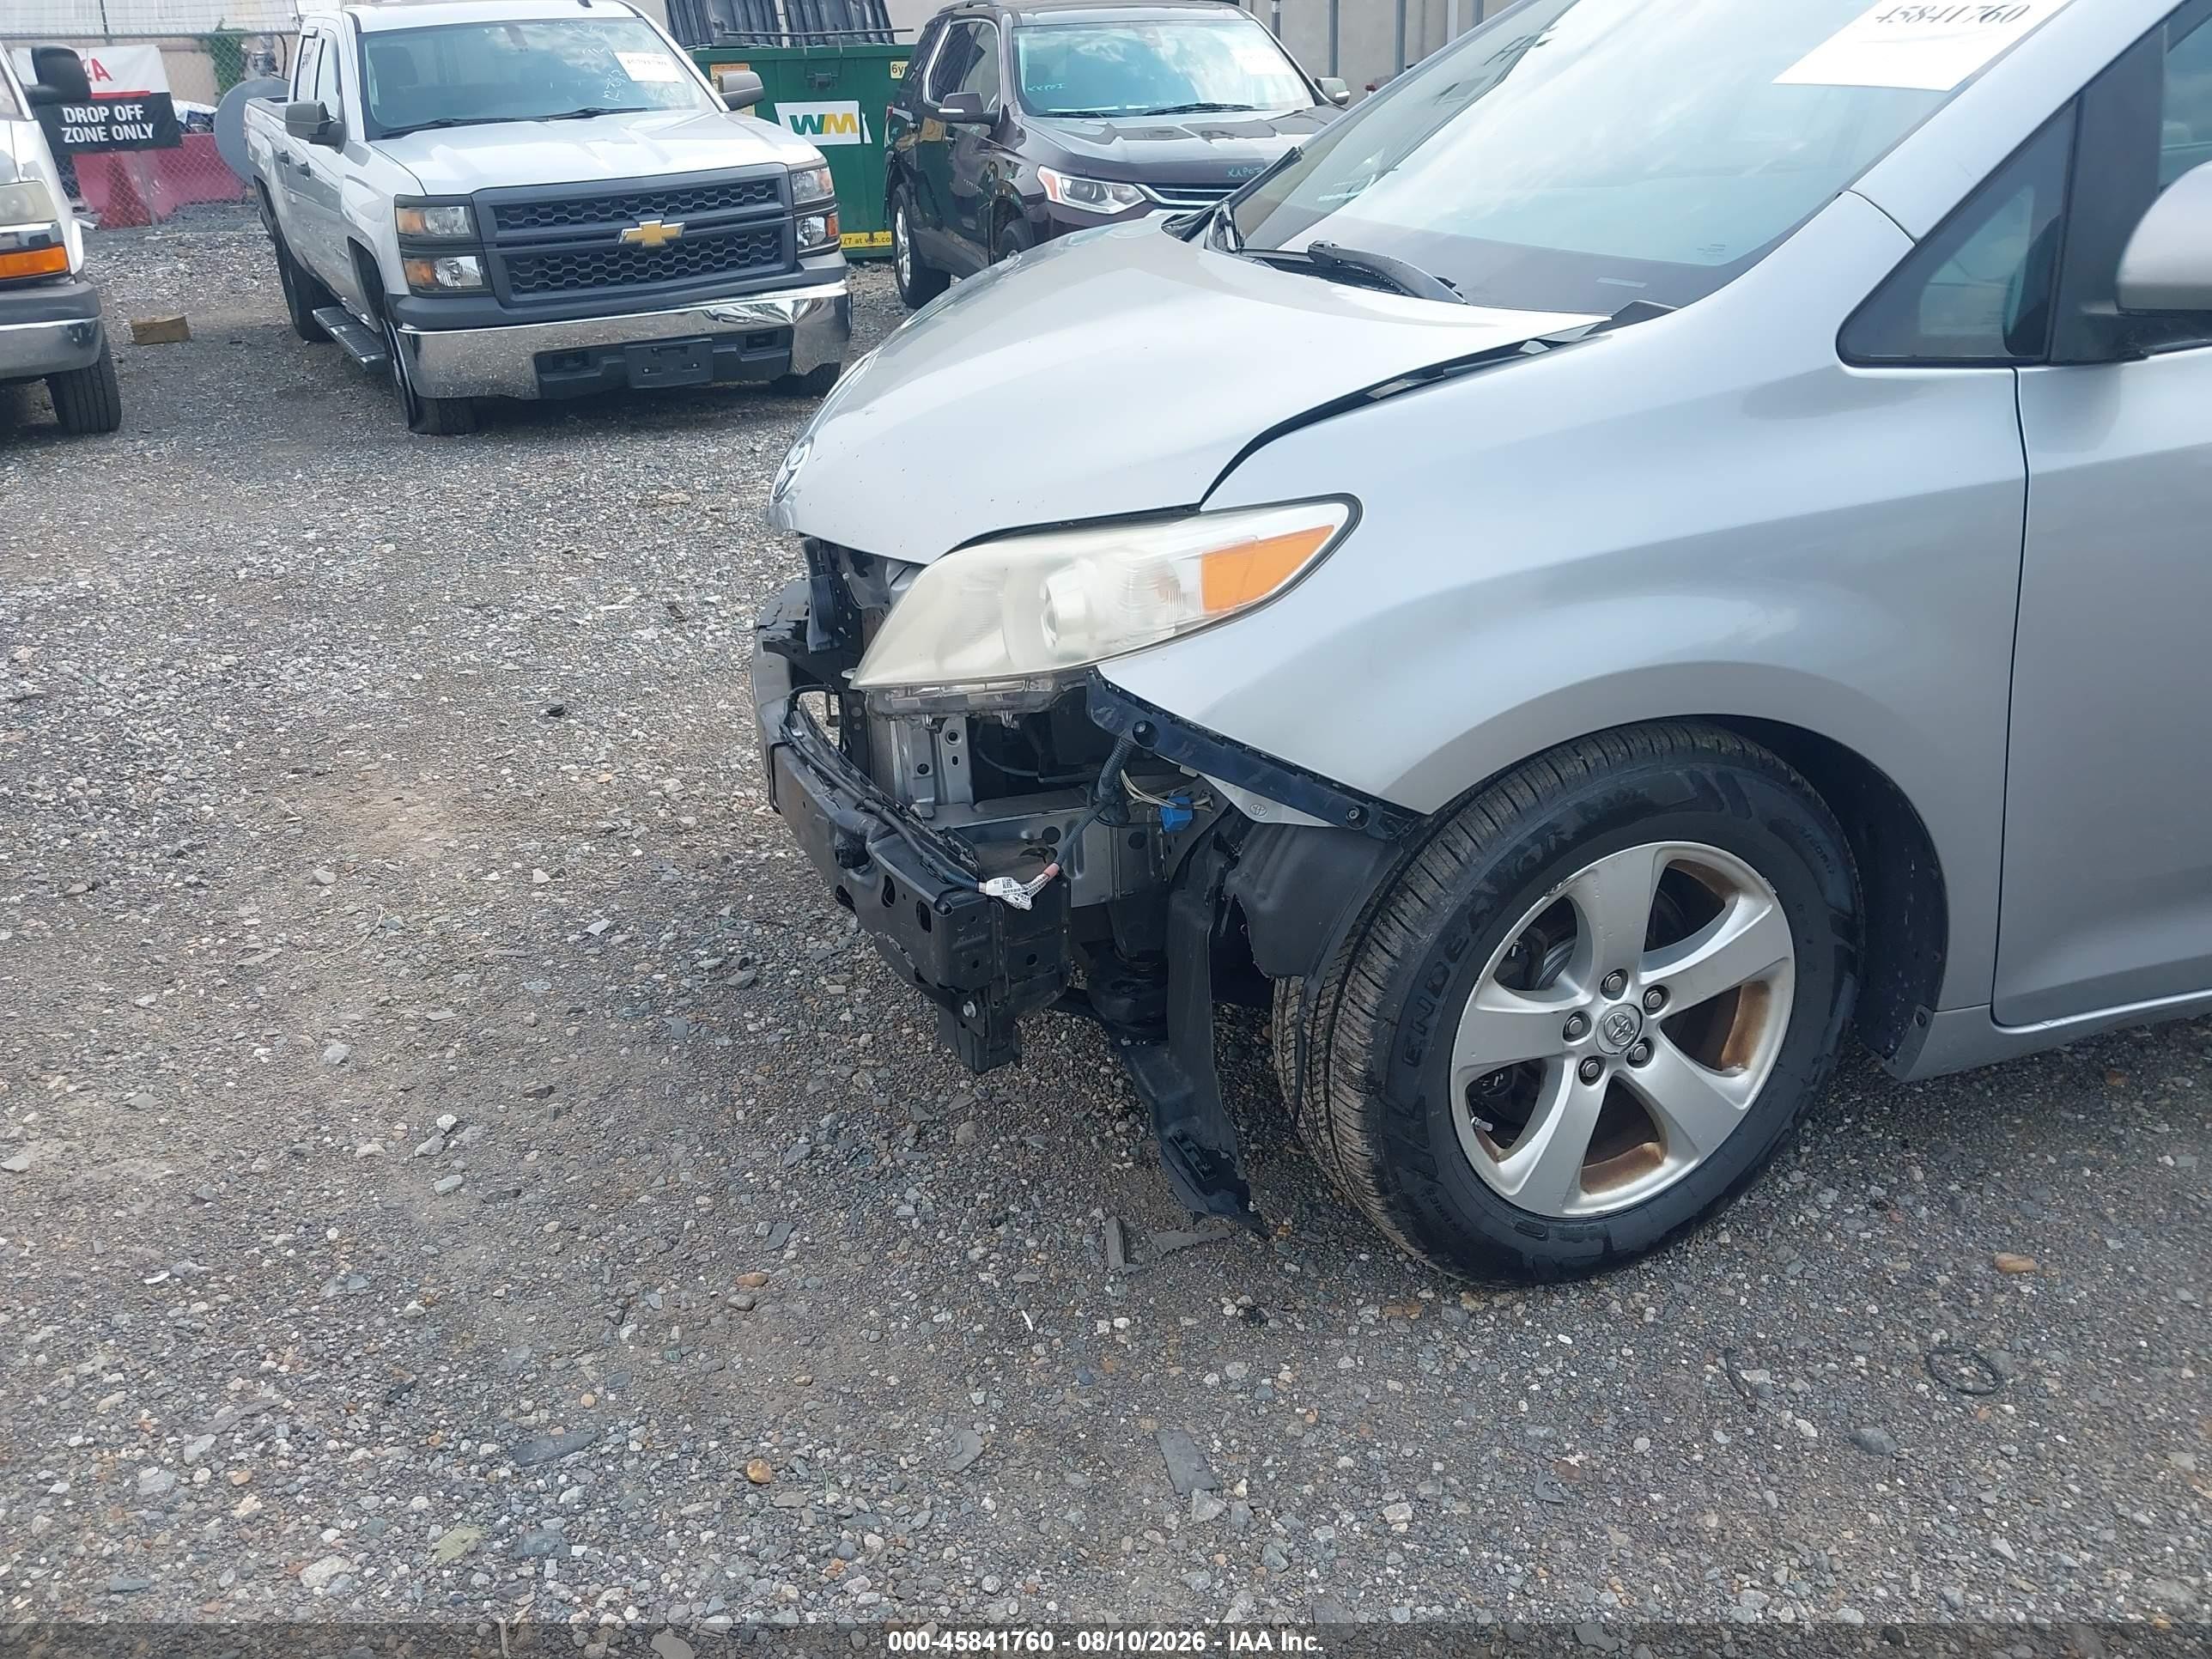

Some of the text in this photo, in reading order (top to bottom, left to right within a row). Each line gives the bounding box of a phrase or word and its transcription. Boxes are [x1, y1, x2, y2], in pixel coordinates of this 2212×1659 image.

[1875, 4, 2031, 24] 45841760
[62, 104, 145, 124] DROP OFF
[788, 112, 859, 136] WM
[61, 123, 155, 143] ZONE ONLY
